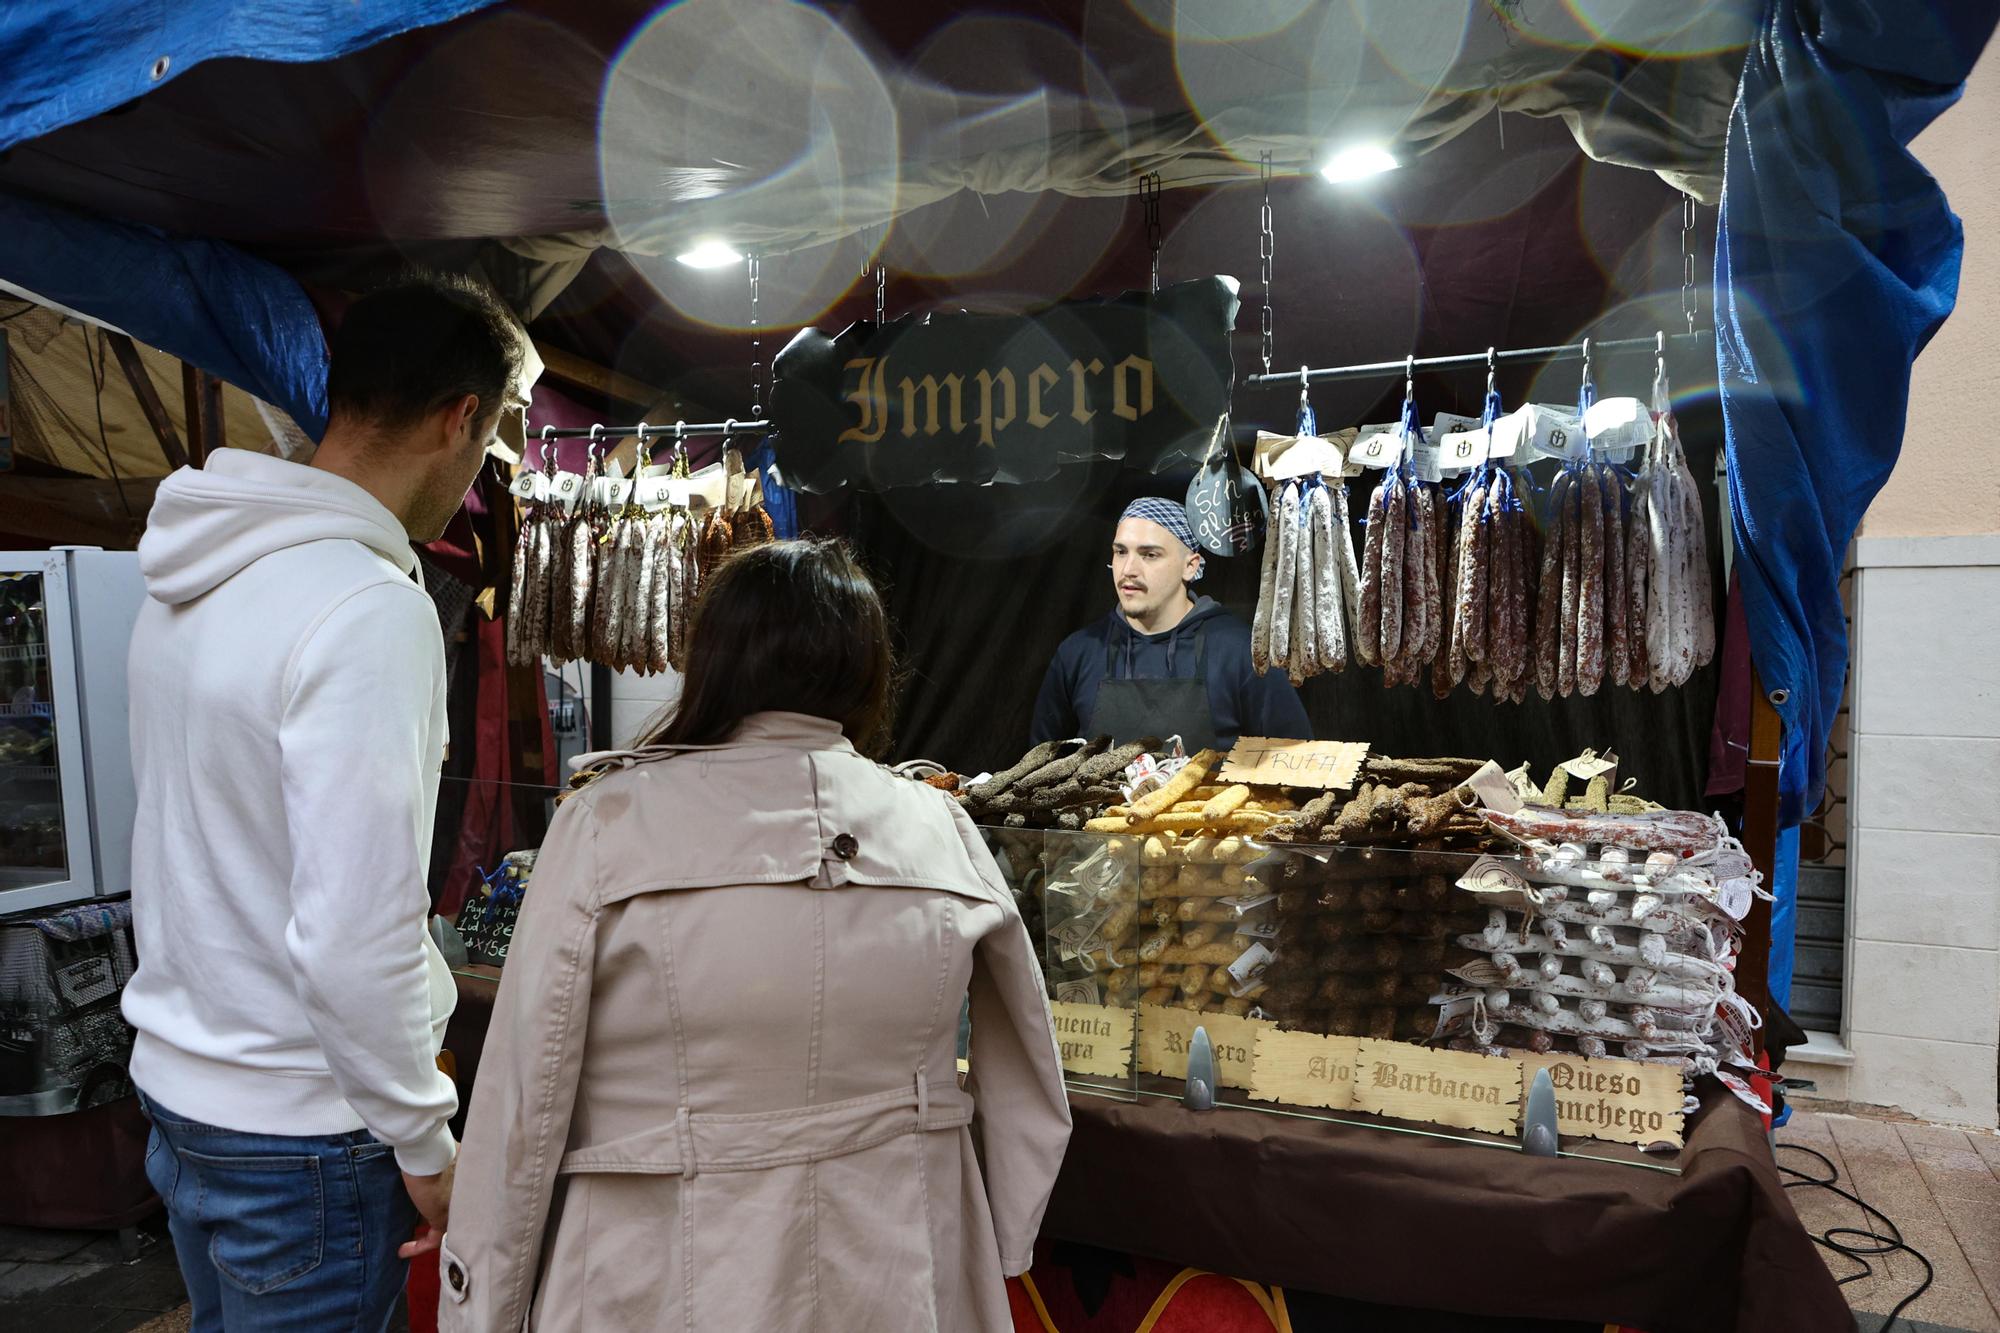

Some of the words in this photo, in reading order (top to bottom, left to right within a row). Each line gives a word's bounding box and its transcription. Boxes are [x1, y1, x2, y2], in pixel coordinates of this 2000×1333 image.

[838, 354, 1154, 449] Impero
[1199, 505, 1263, 549] gluten
[1246, 749, 1338, 772] TRUFA
[1162, 1030, 1247, 1063] Rero
[1371, 1061, 1501, 1105] Barbacoa
[1548, 1062, 1641, 1096] Queso
[1555, 1097, 1663, 1135] anchego
